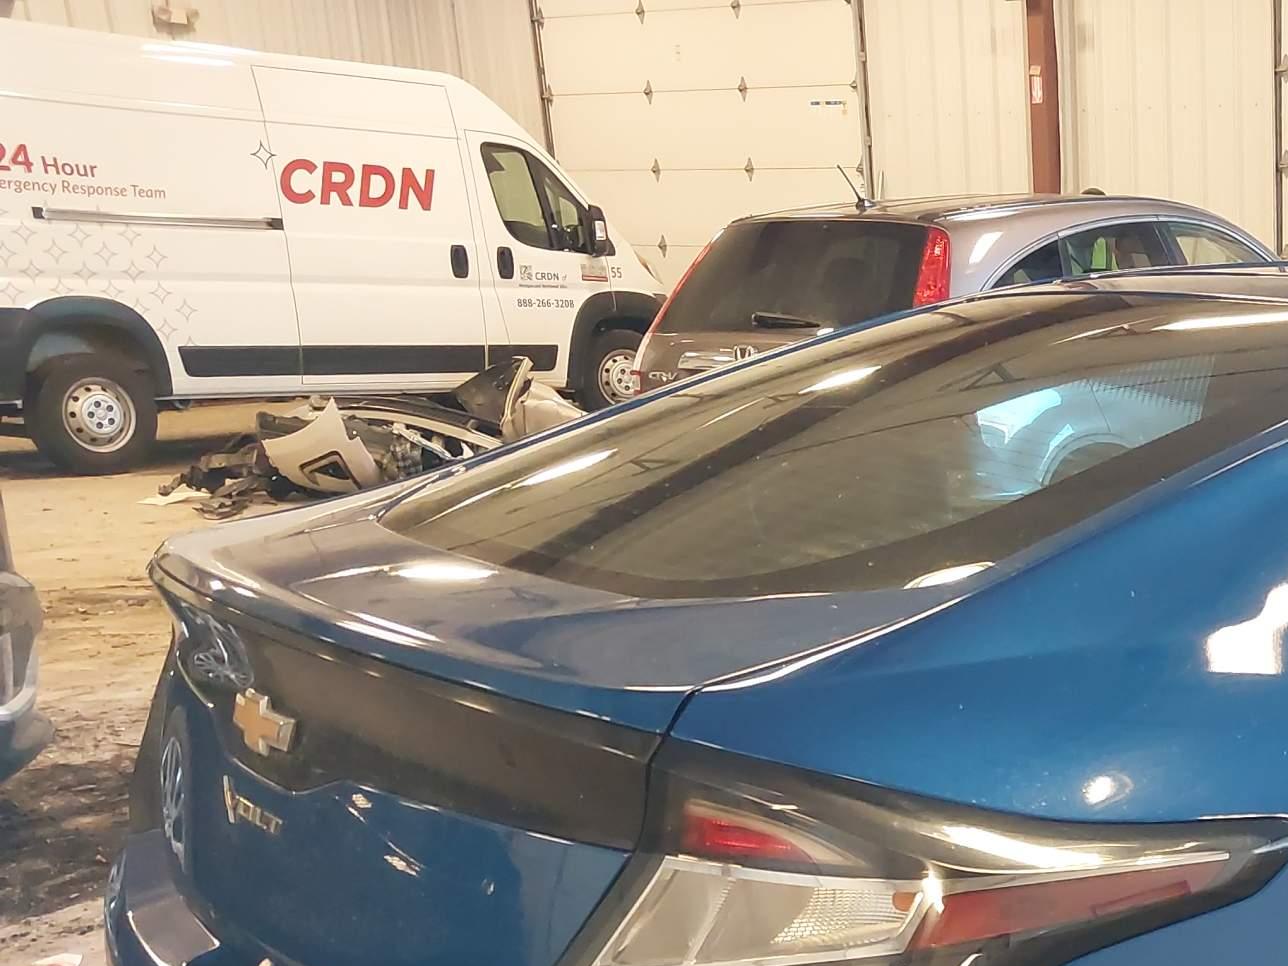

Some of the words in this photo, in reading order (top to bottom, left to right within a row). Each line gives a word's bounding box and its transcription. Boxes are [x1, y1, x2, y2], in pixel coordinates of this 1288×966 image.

[40, 155, 98, 178] Hour
[61, 179, 128, 198] Response
[130, 184, 167, 200] Team
[279, 158, 435, 211] CRDN
[534, 271, 560, 281] CRDN
[610, 266, 623, 279] 55
